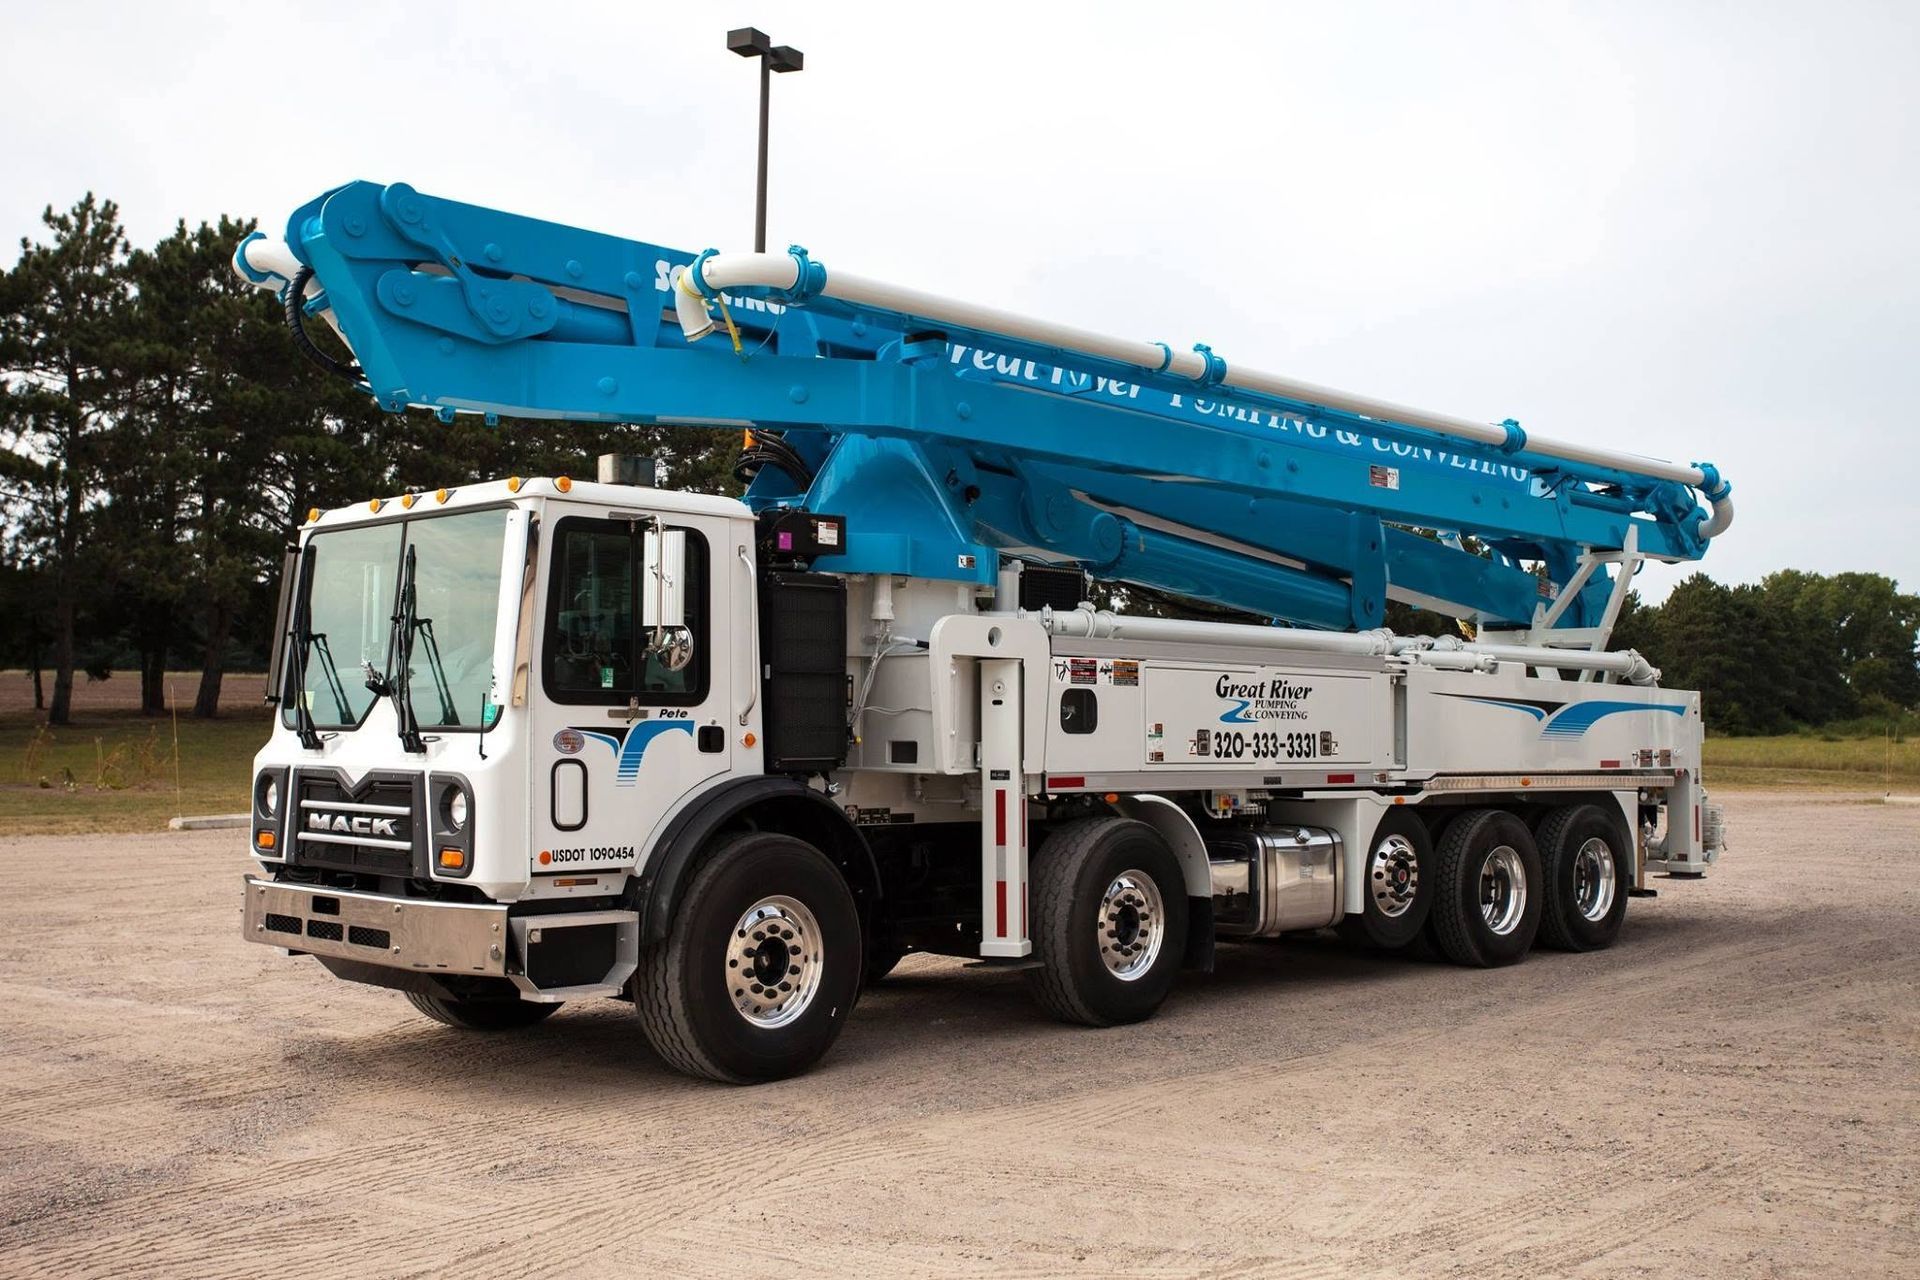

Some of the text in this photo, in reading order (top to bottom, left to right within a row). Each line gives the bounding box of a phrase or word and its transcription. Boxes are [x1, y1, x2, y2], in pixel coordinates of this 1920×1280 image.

[946, 343, 1038, 381] reat
[1216, 674, 1312, 699] Great River
[659, 709, 688, 718] Pete
[1255, 700, 1297, 709] PUMPING
[1243, 710, 1308, 720] & CONVEYING
[1214, 731, 1317, 758] 320-333-3331
[309, 812, 398, 836] MACK
[552, 847, 634, 862] USDOT 1090454
